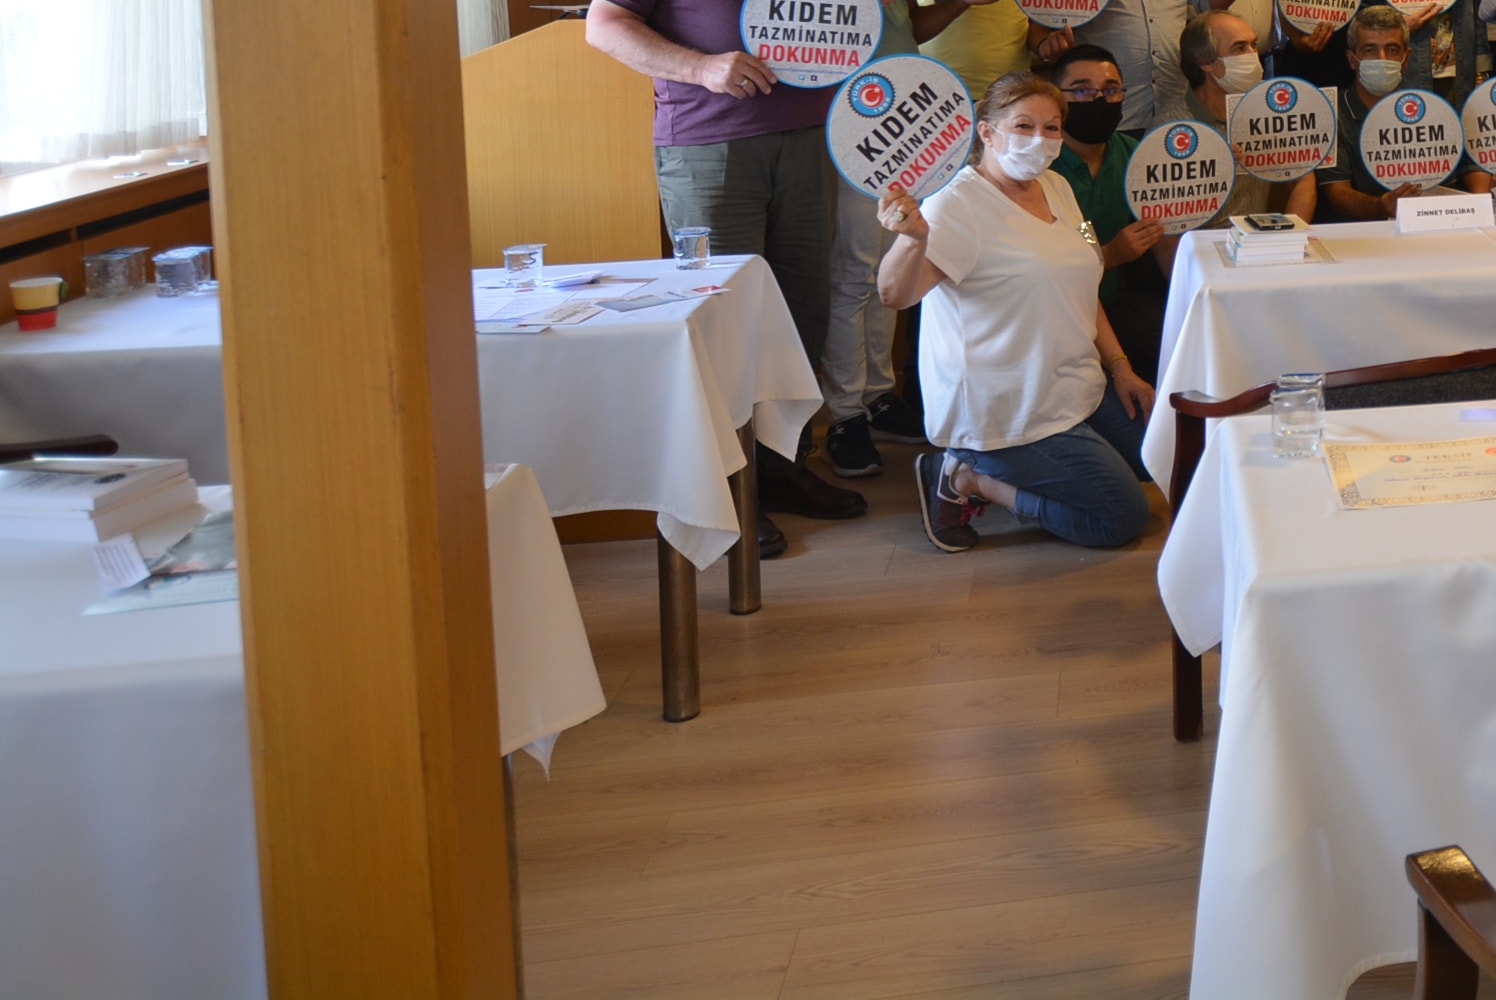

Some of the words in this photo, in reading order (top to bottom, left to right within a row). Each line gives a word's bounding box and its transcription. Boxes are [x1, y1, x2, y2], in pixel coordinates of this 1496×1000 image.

[768, 0, 858, 26] KIDEM
[1286, 4, 1348, 22] DOKUNMA
[749, 25, 872, 46] TAZMİNATIMA
[758, 44, 860, 67] DOKUNMA
[856, 82, 938, 163] KIDEM
[1250, 112, 1316, 136] KIDEM
[863, 92, 965, 191] TAZMİNATIMA
[1379, 124, 1444, 146] KIDEM
[1245, 148, 1322, 168] DOKUNMA
[1367, 144, 1458, 162] TAZMİNATIMA
[1146, 159, 1216, 184] KIDEM
[1376, 159, 1451, 178] DOKUNMA
[1132, 181, 1228, 202] TAZMİNATIMA
[1140, 197, 1219, 220] DOKUNMA
